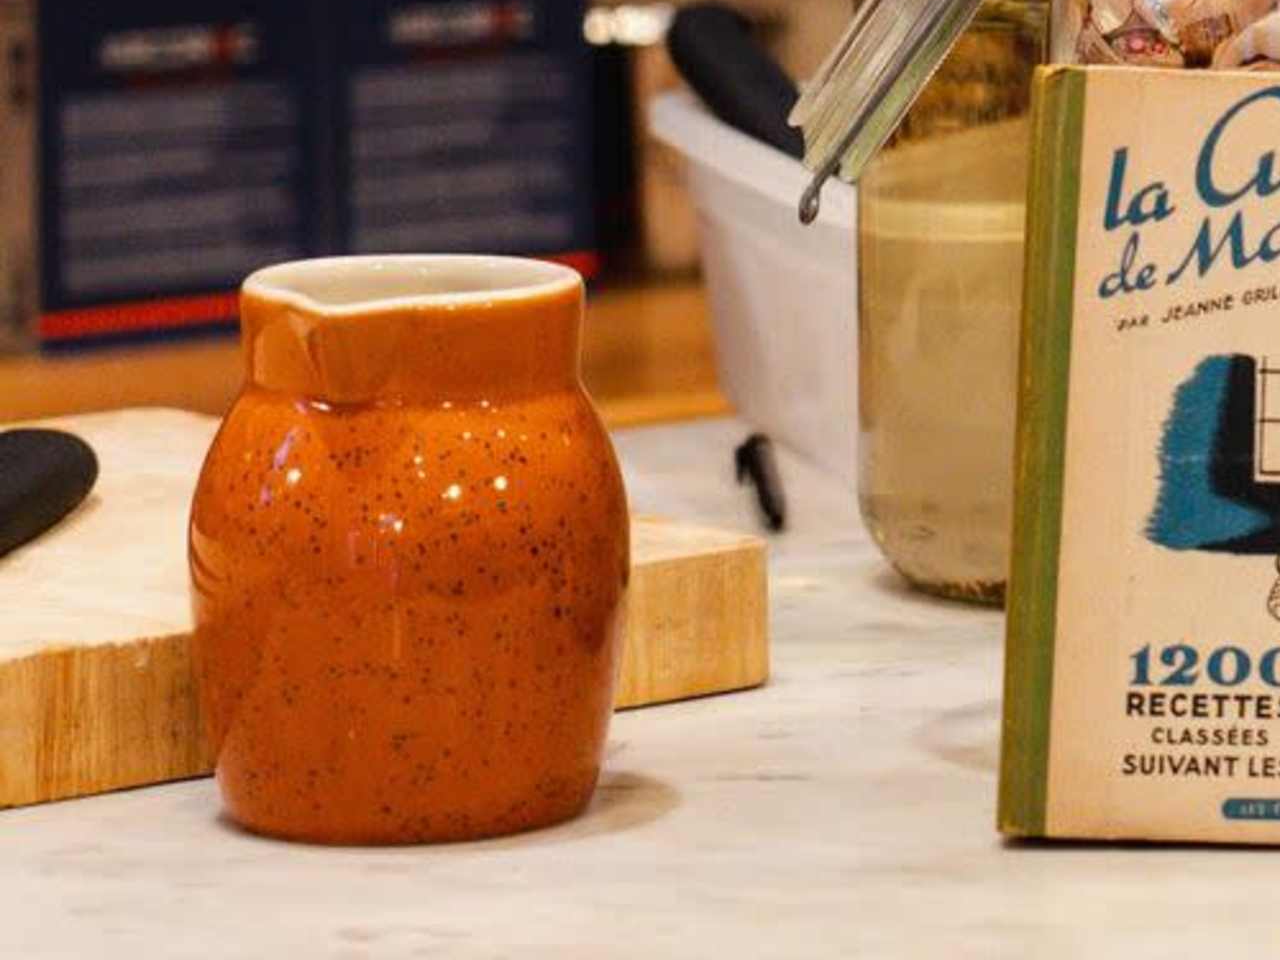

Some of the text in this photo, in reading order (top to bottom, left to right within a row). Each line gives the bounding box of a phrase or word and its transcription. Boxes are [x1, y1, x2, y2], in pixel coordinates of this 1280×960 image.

[1103, 146, 1175, 232] la
[1097, 232, 1160, 299] de
[1117, 315, 1149, 332] PAR
[1161, 294, 1234, 324] JEANNE
[1150, 723, 1270, 747] CLASSÉES
[1122, 754, 1238, 778] SUIVANT
